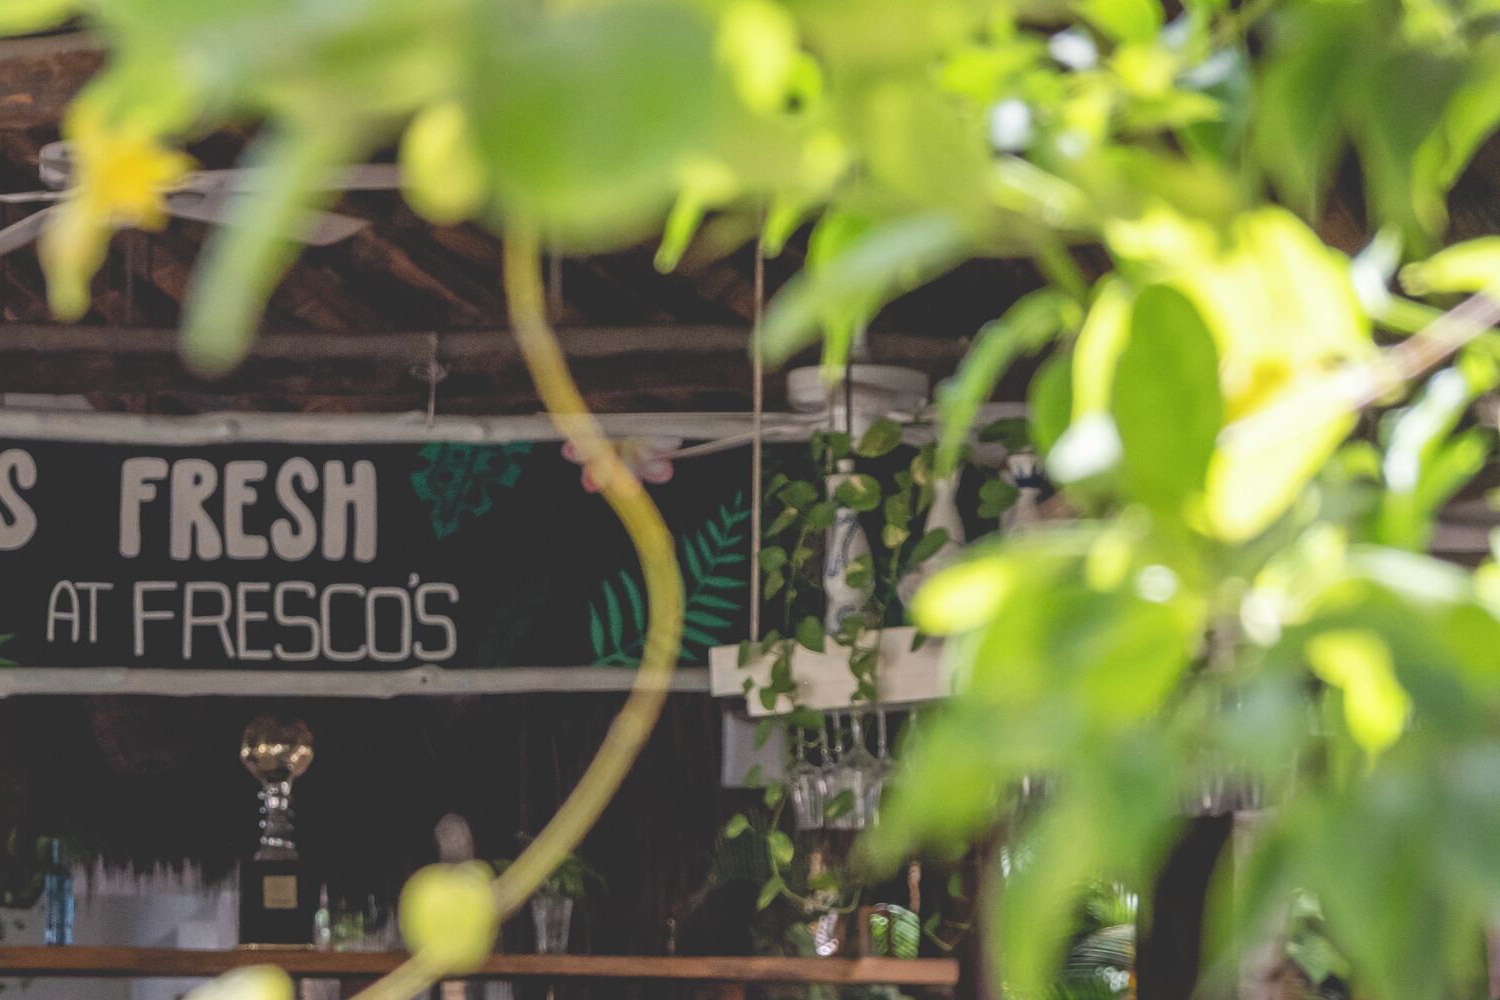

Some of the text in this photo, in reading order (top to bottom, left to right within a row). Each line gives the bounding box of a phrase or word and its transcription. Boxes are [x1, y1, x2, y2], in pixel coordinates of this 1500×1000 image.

[118, 456, 378, 563] FRESH
[46, 573, 459, 662] AT FRESCO'S
